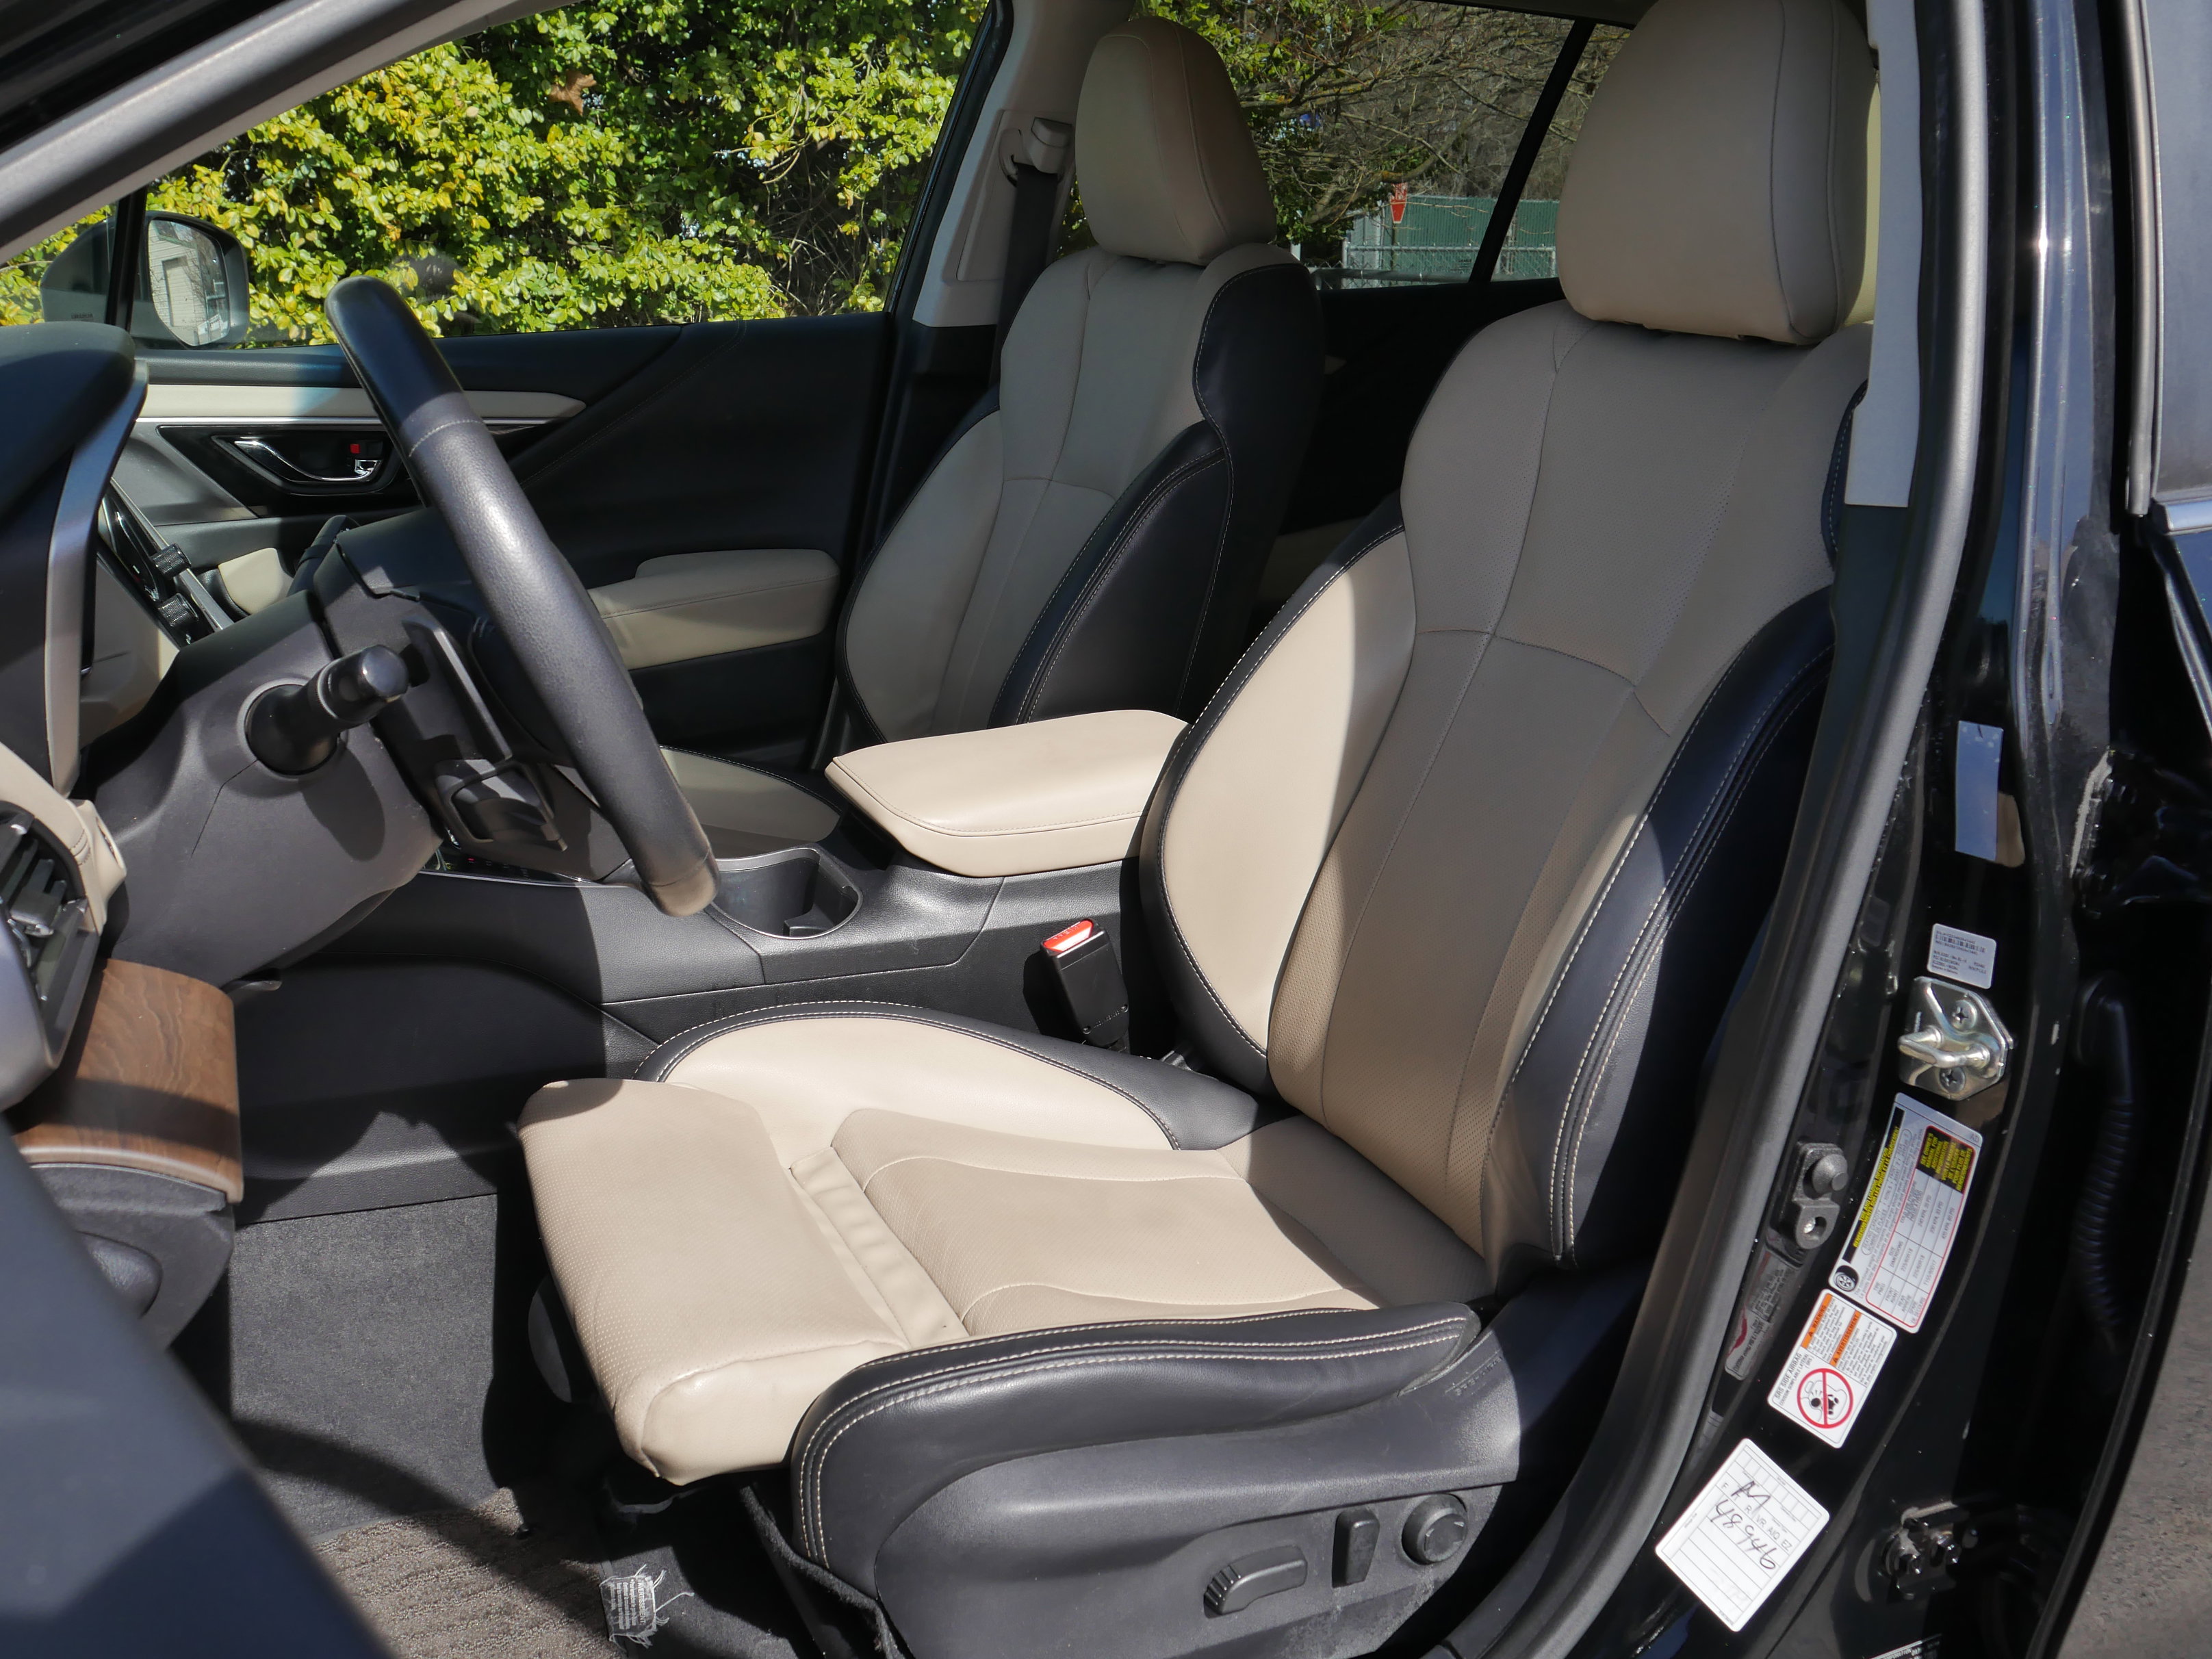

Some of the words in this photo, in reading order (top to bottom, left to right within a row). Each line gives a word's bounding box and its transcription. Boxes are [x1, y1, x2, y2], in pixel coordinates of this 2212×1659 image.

[1811, 1304, 1827, 1328] WARNING
[1835, 1314, 1860, 1356] AVERTISSEMENT
[1774, 1387, 1784, 1399] SRS
[1780, 1373, 1791, 1387] SIDE
[1787, 1352, 1802, 1374] AIRBAG
[1710, 1499, 1777, 1570] 48946
[1721, 1482, 1729, 1490] F
[1744, 1505, 1752, 1514] R
[1754, 1515, 1767, 1528] VR
[1780, 1539, 1792, 1551] EZ
